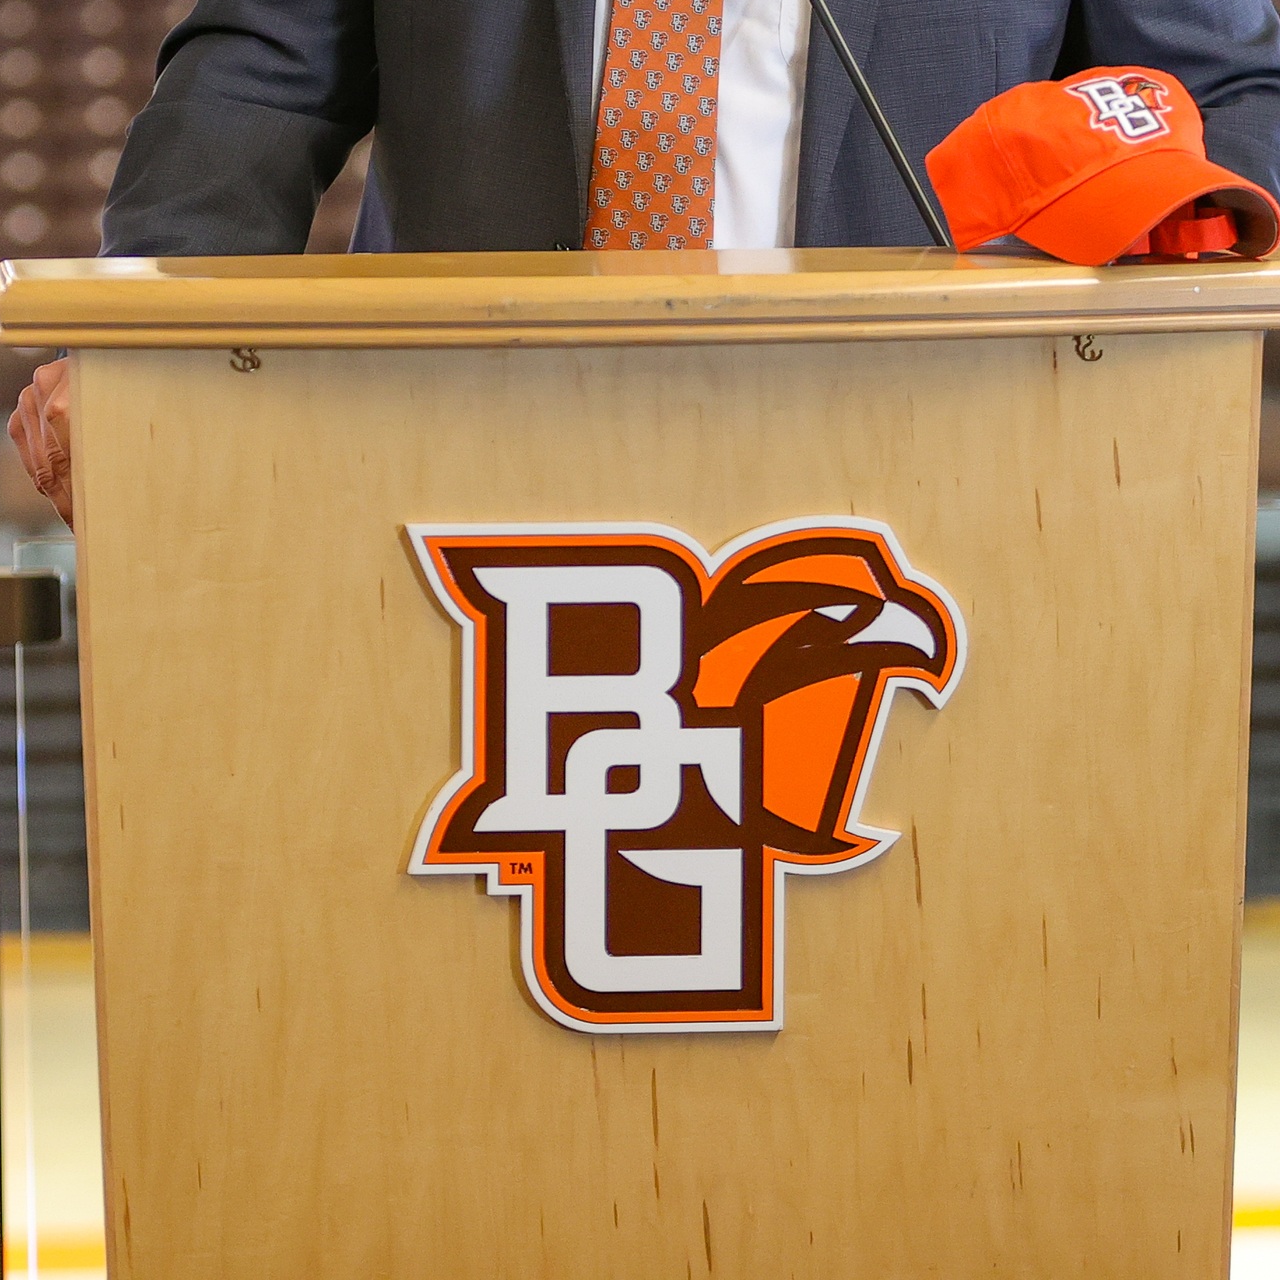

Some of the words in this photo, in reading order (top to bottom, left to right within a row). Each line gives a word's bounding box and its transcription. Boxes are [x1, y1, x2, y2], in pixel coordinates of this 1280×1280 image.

[1080, 80, 1160, 138] BG
[473, 566, 742, 992] BG
[508, 862, 534, 875] TM
